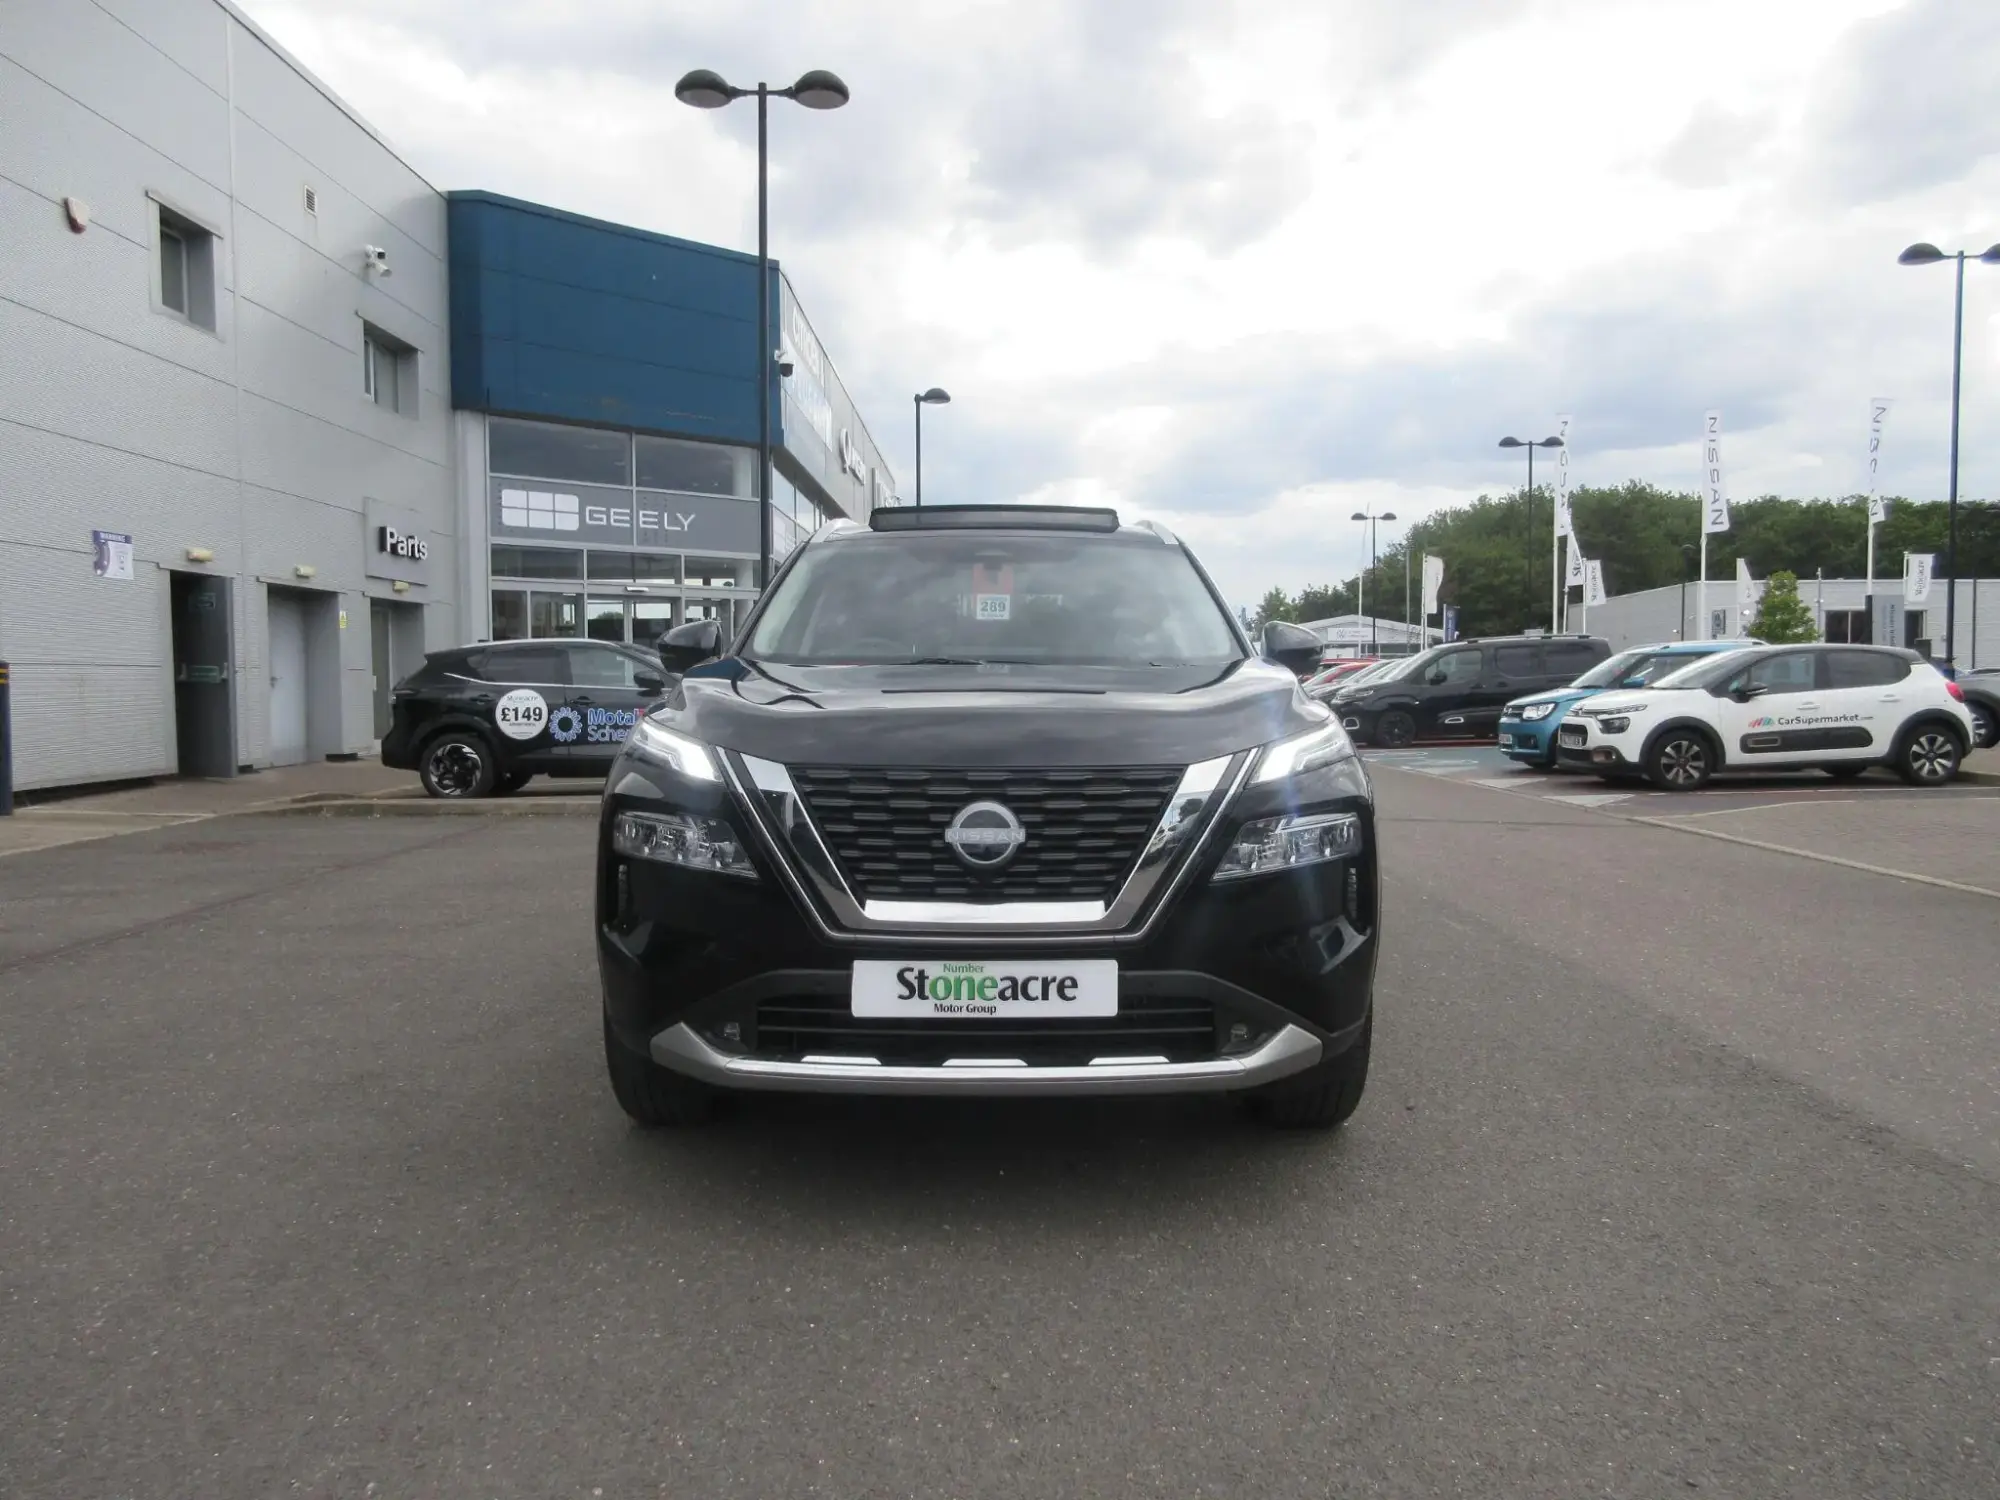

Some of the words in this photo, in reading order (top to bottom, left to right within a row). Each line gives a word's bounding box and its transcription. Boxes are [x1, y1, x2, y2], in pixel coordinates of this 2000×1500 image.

[1708, 416, 1724, 526] NISSAN
[1870, 407, 1886, 516] NISN
[585, 505, 696, 532] GEELY
[381, 526, 428, 560] Parts
[501, 706, 543, 722] £149
[588, 725, 630, 742] Sche
[947, 831, 1023, 841] NISSAN
[943, 963, 984, 973] Number
[896, 966, 1078, 1002] Stoneacre
[934, 1003, 963, 1014] Motor
[966, 1003, 997, 1015] Group
